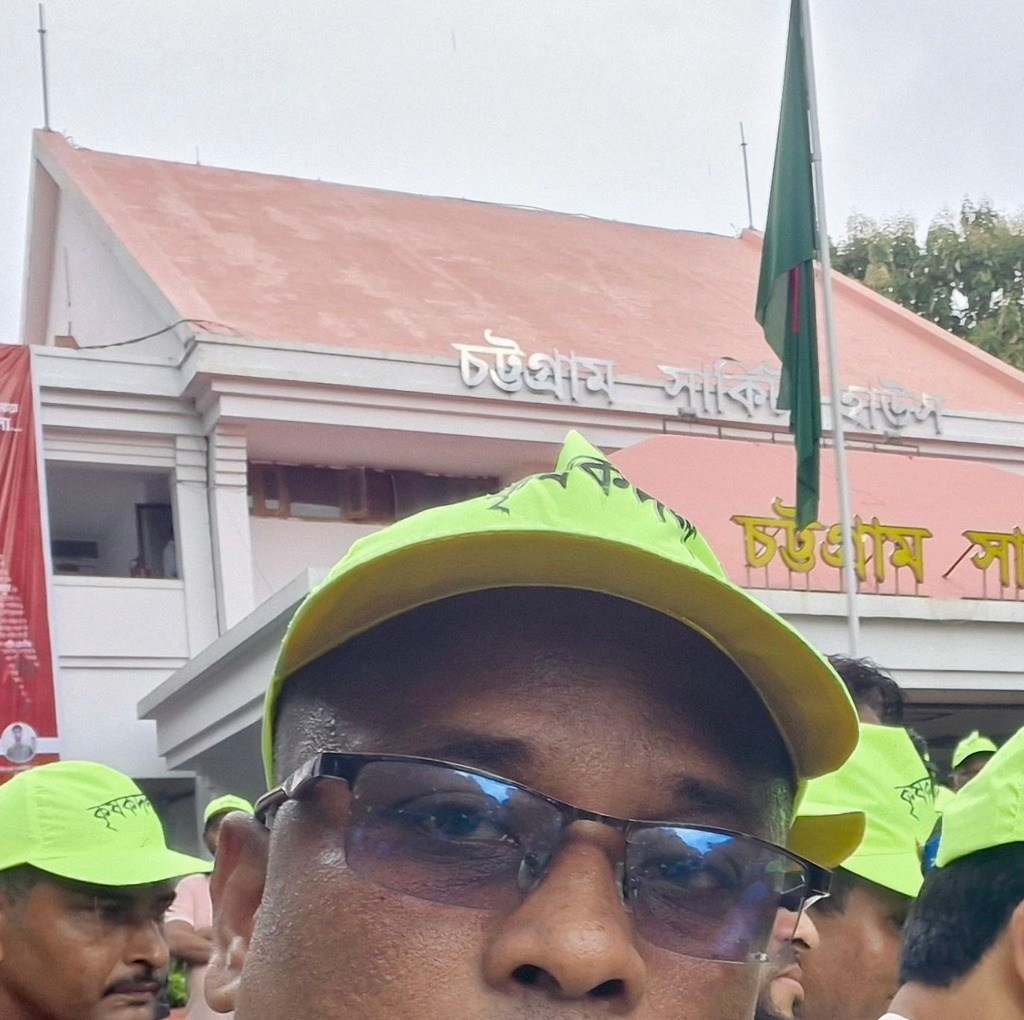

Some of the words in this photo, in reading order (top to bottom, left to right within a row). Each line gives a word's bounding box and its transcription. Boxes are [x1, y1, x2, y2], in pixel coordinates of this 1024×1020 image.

[451, 329, 617, 405] চট্টগ্রাম
[838, 375, 945, 436] হাউস
[731, 496, 932, 585] চট্টগ্রাম
